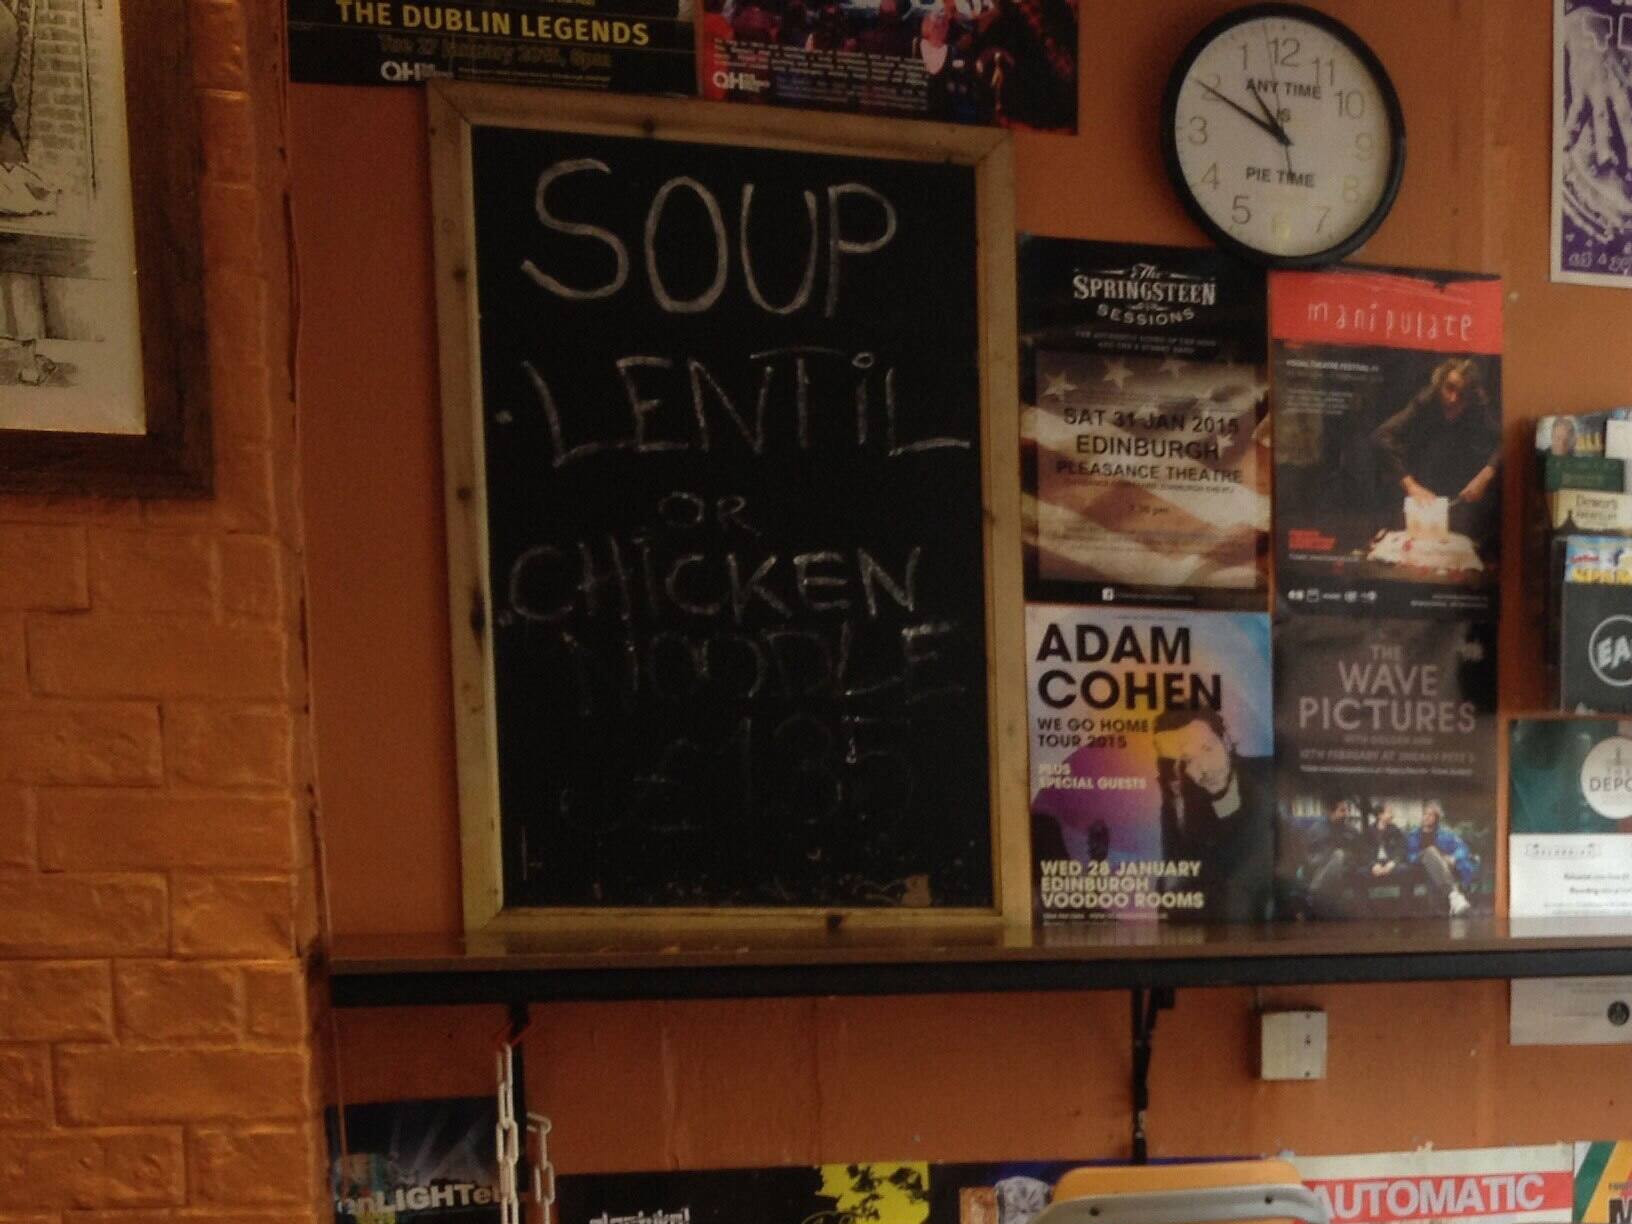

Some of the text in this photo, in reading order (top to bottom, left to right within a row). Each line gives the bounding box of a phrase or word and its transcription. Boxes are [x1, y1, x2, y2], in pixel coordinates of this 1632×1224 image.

[336, 0, 650, 46] THE DUBLIN LEGENDS
[1239, 44, 1249, 70] 1
[1269, 37, 1300, 67] 12
[1312, 56, 1336, 87] 11
[1245, 78, 1322, 99] ANY TIME
[1334, 89, 1365, 120] 10
[1187, 116, 1209, 146] 3
[1354, 131, 1373, 162] 9
[1201, 162, 1220, 191] 4
[1245, 166, 1316, 188] PIE TIME
[1231, 194, 1250, 225] 5
[1315, 205, 1331, 233] 7
[521, 157, 897, 318] SOUP
[1130, 262, 1160, 279] The
[1073, 274, 1216, 306] SPRINGSTEEN
[1097, 303, 1195, 326] SESSIONS
[1308, 301, 1473, 342] manipulate
[1063, 407, 1107, 426] SAT
[1114, 410, 1135, 428] 31
[1146, 412, 1185, 432] JAN
[1076, 434, 1220, 461] EDINBURGH
[1056, 459, 1242, 484] PLEASANCE THEATRE
[659, 491, 761, 538] OR
[1036, 623, 1191, 665] ADAM
[1038, 669, 1222, 711] COHEN
[1338, 658, 1439, 697] WAVE
[1038, 718, 1149, 734] WE GO HOME
[1299, 695, 1477, 735] PICTURES
[1038, 733, 1128, 749] TOUR 2015
[1038, 776, 1148, 791] SPECIAL GUESTS
[1040, 860, 1202, 878] WED 28 JANUARY
[1040, 876, 1149, 892] EDINBURGH
[1041, 892, 1205, 909] VOODOO ROOMS
[1312, 1172, 1546, 1221] AUTOMATIC
